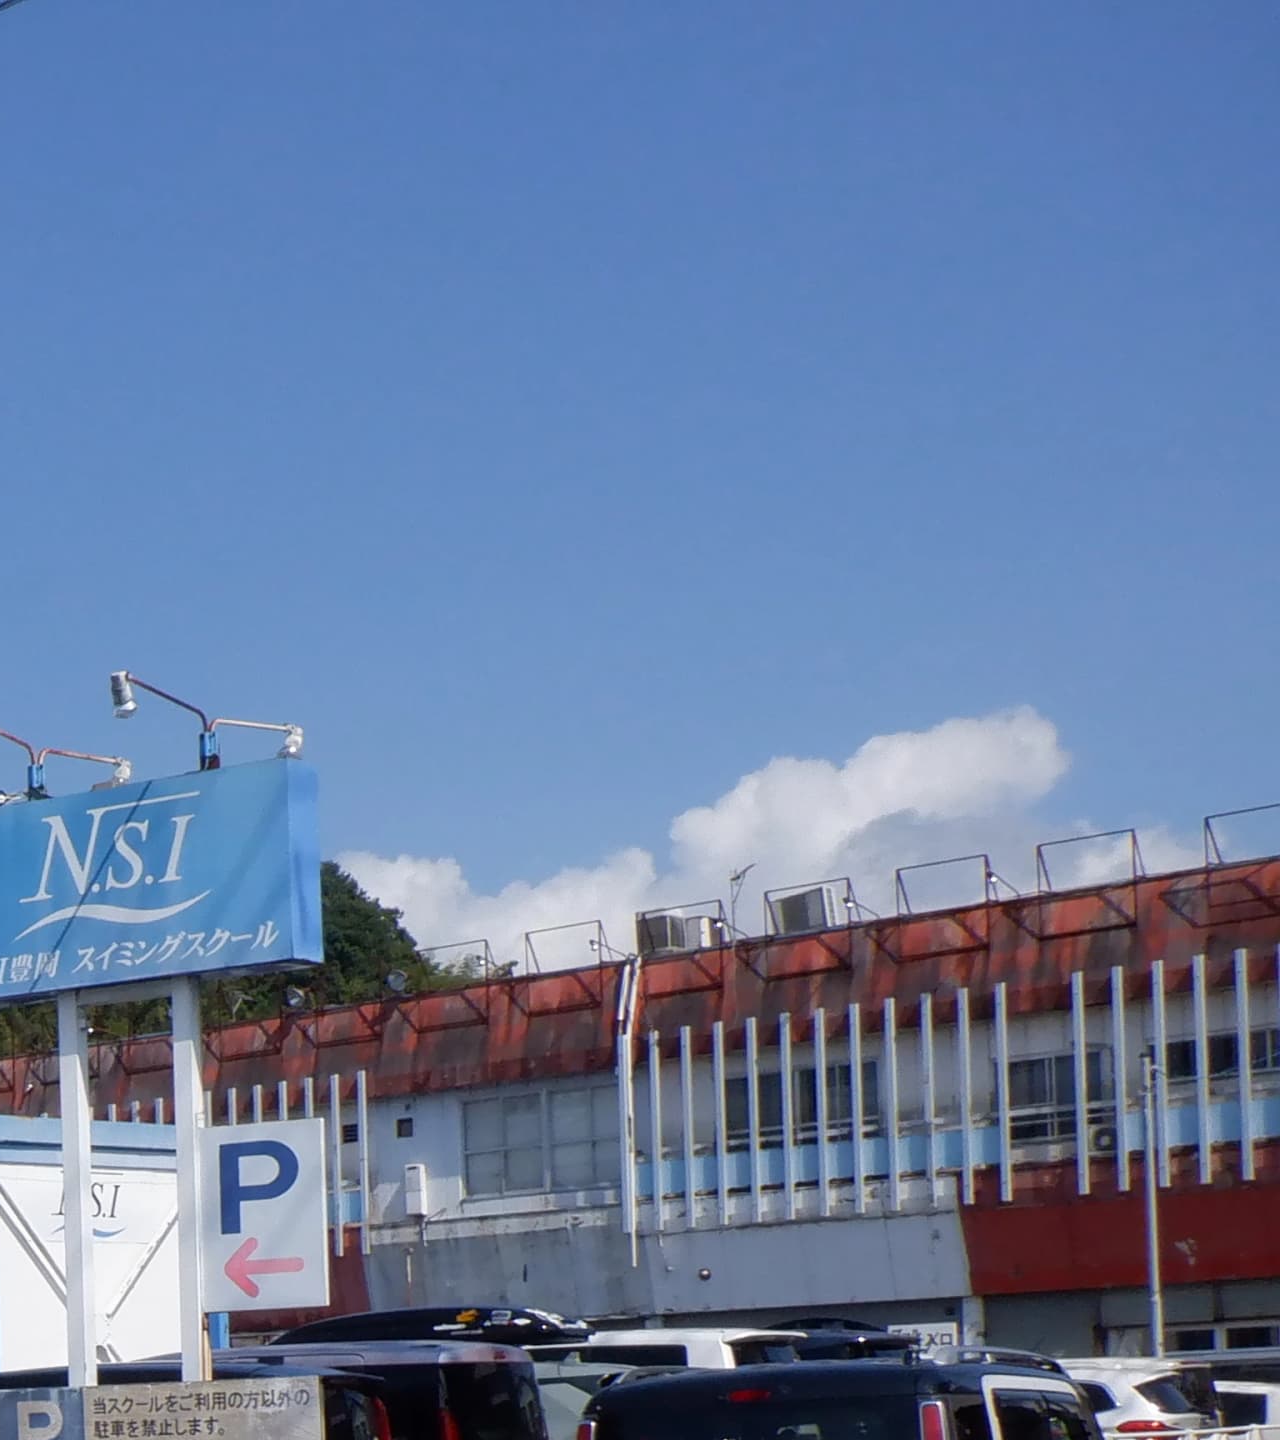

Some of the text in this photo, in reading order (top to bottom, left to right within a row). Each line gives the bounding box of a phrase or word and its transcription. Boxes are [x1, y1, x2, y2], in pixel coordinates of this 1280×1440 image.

[71, 920, 280, 974] スイミングスクール
[219, 1140, 299, 1235] P
[93, 1388, 311, 1415] 当スクールをご利用の方以外の
[94, 1415, 225, 1438] 駐車を禁止します。
